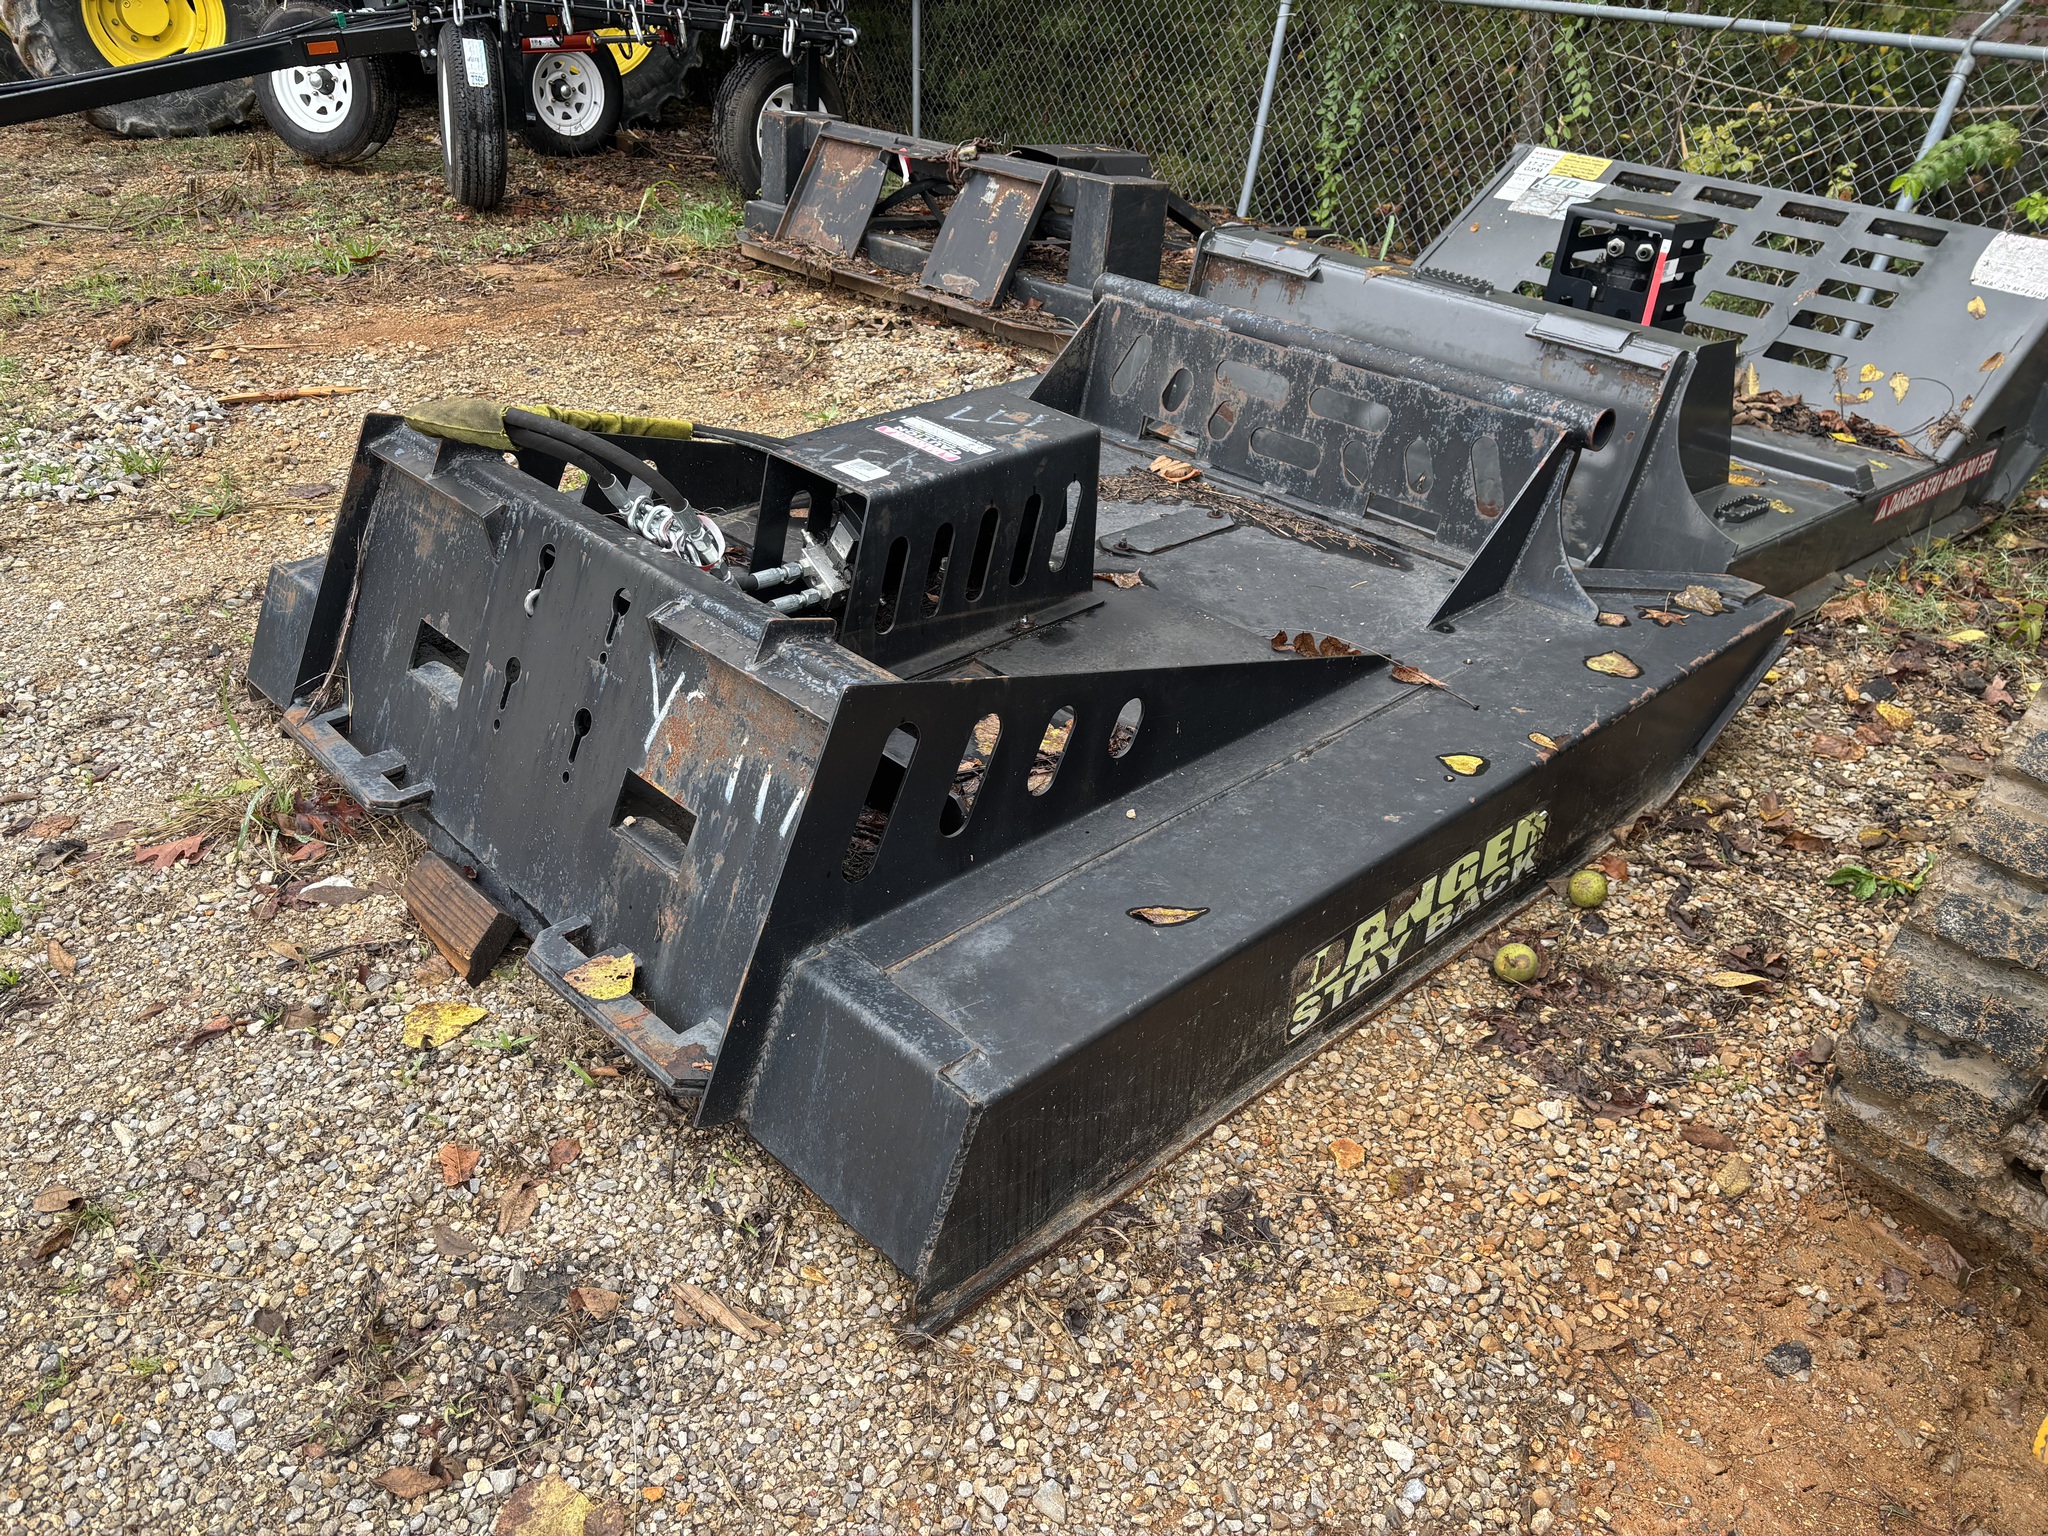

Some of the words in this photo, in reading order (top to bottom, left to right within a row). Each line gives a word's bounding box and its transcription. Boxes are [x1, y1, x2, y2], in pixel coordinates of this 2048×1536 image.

[1542, 177, 1580, 190] CID
[894, 426, 962, 455] CAUTION
[1887, 482, 1926, 517] DANGER
[1921, 472, 1947, 500] STAY
[1942, 462, 1965, 490] BACK
[1975, 449, 1998, 475] FEET
[1290, 929, 1413, 1036] STAY
[1425, 848, 1537, 944] BACK
